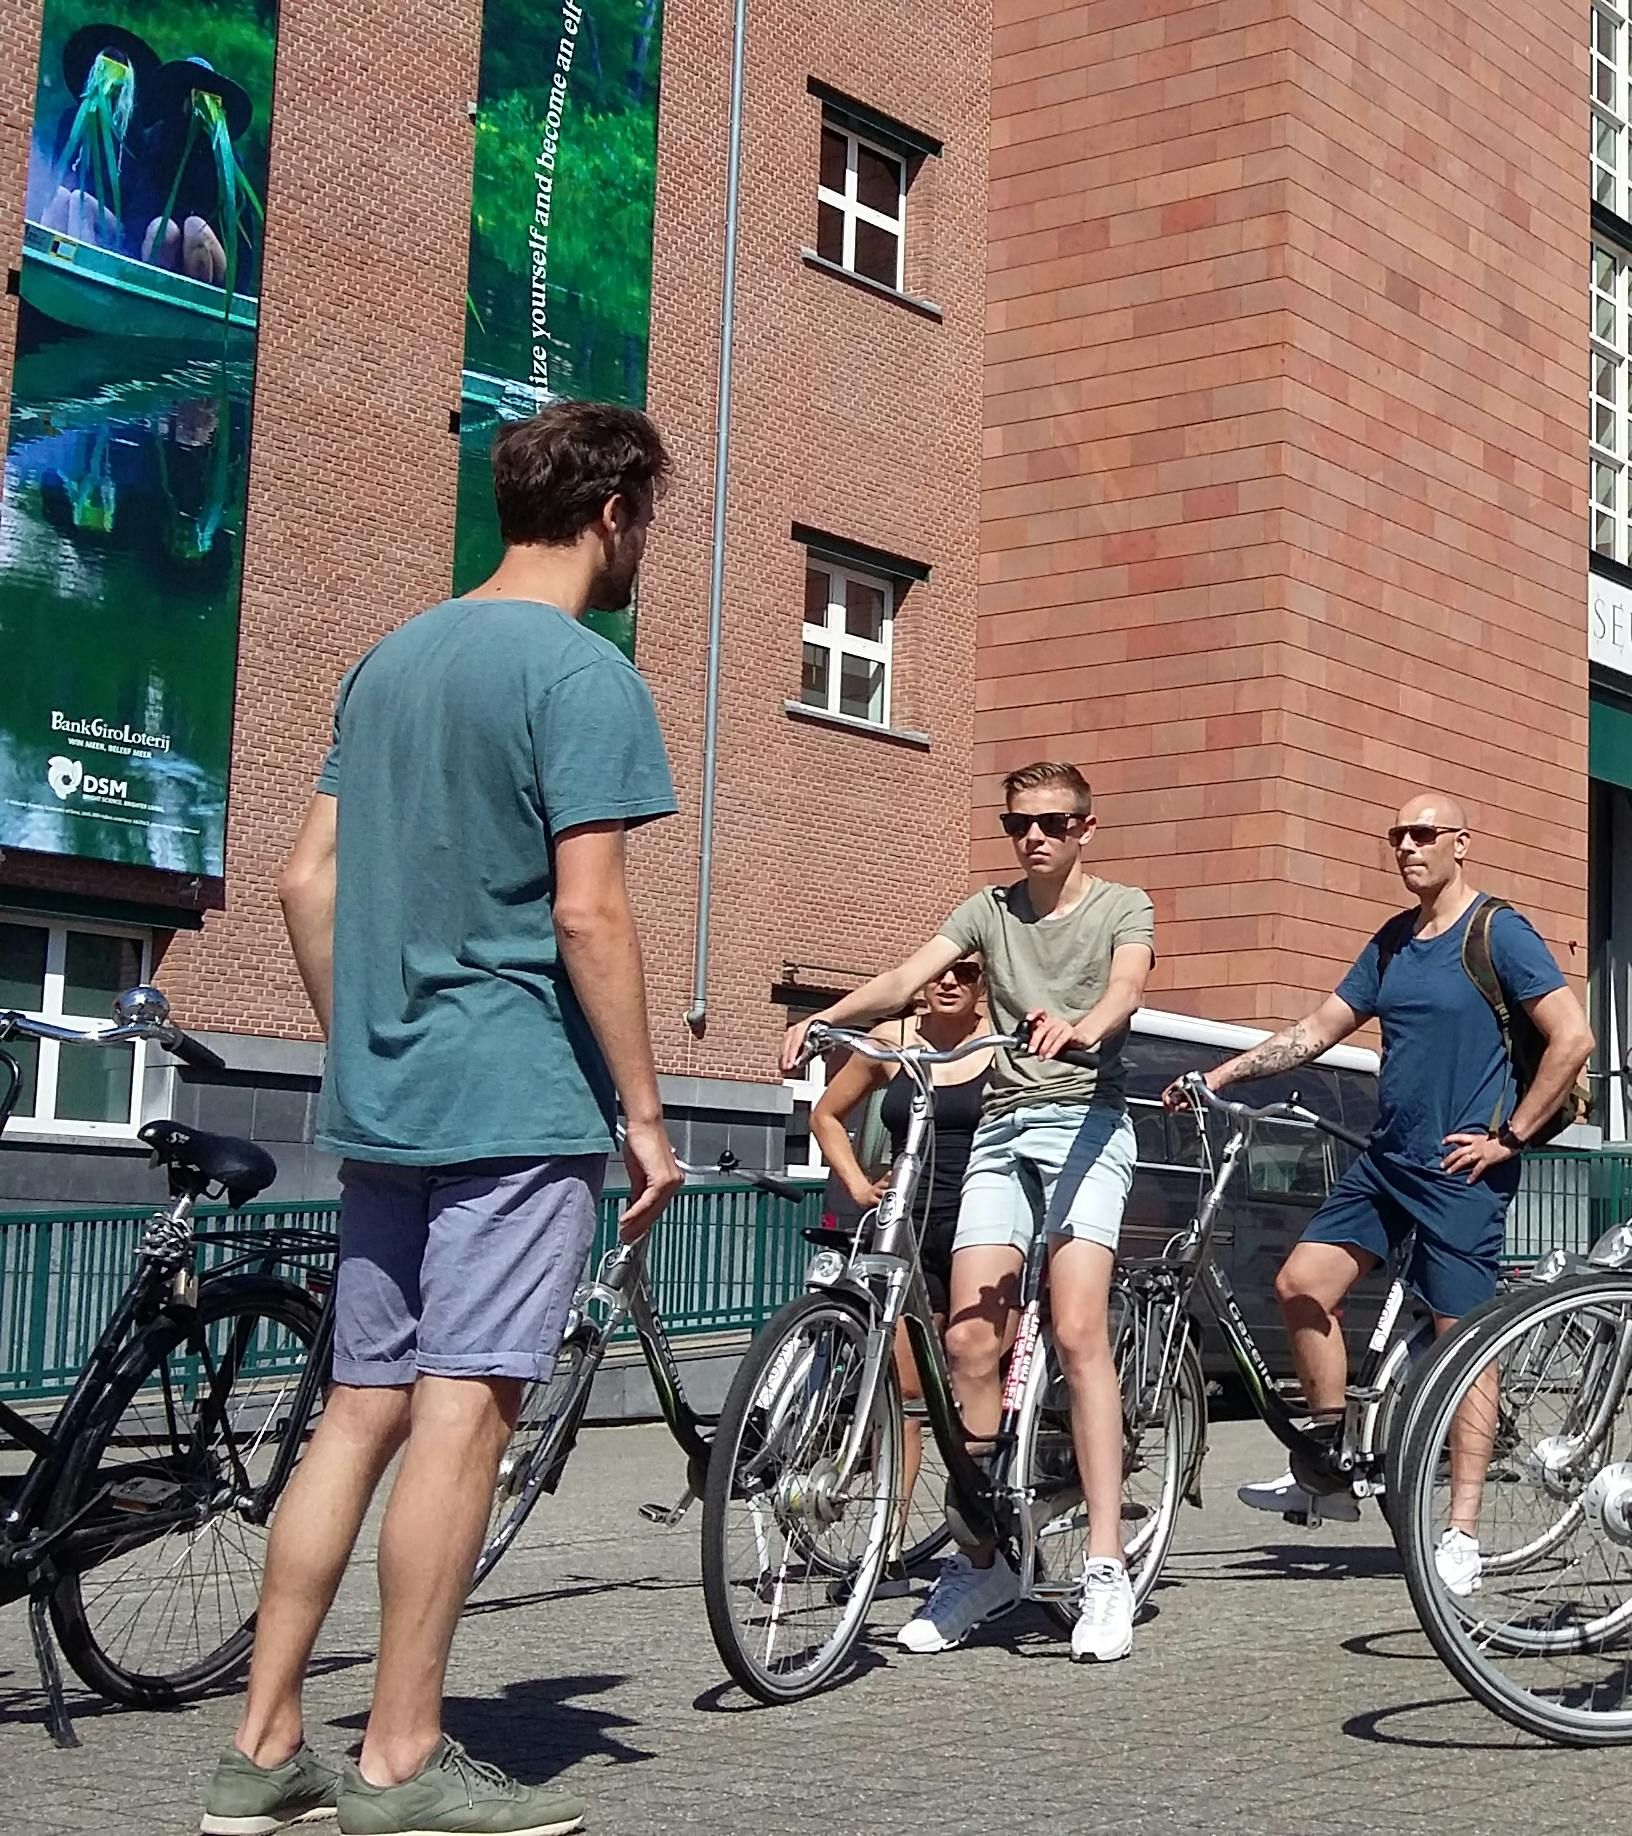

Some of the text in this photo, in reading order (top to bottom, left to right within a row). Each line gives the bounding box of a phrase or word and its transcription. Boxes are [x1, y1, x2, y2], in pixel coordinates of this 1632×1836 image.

[556, 38, 575, 72] an
[536, 72, 567, 172] become
[534, 172, 553, 227] and
[529, 225, 551, 340] yourself
[51, 711, 171, 754] BankGiroLoterij
[83, 775, 128, 799] DSM
[653, 1315, 687, 1404] Gazelle
[1228, 1301, 1275, 1390] Gazelle
